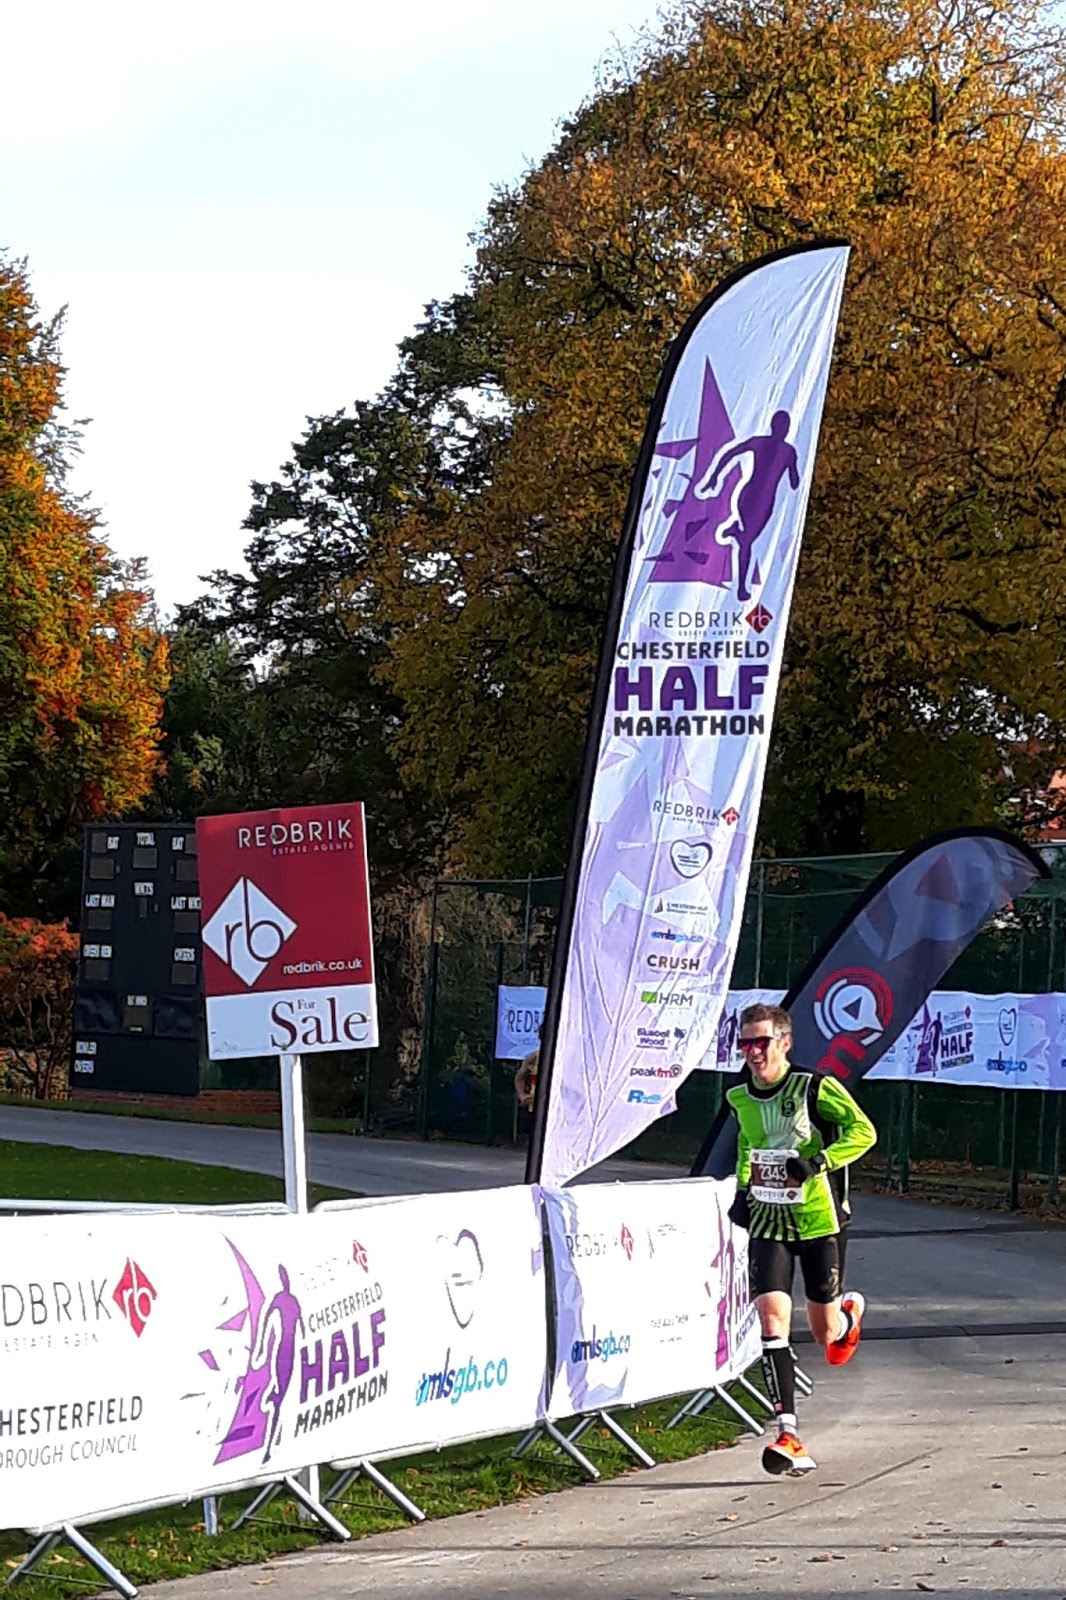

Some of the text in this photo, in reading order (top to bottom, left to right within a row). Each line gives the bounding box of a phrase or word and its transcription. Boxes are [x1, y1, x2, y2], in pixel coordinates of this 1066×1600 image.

[649, 611, 743, 628] REDBRIK
[617, 640, 770, 660] CHESTERFIELD
[614, 664, 769, 711] HALF
[614, 715, 764, 737] MARATHON
[652, 799, 721, 821] REDBRIK
[238, 818, 353, 849] REDBRIK
[272, 841, 354, 855] ESTATE AGENTS
[225, 877, 285, 967] rb
[282, 957, 363, 976] redbrik.co.uk
[647, 954, 700, 971] CRUSH
[297, 998, 316, 1011] For
[659, 992, 694, 1006] HRM
[270, 995, 369, 1049] Sale
[640, 1037, 665, 1046] Wood
[940, 1031, 973, 1059] HALF
[629, 1066, 673, 1078] peakfm
[2, 1278, 112, 1327] DBRIK
[308, 1282, 383, 1333] CHESTERFIELD
[299, 1307, 386, 1405] HALF
[294, 1370, 388, 1438] MARATHON
[70, 1433, 138, 1462] COUNCIL
